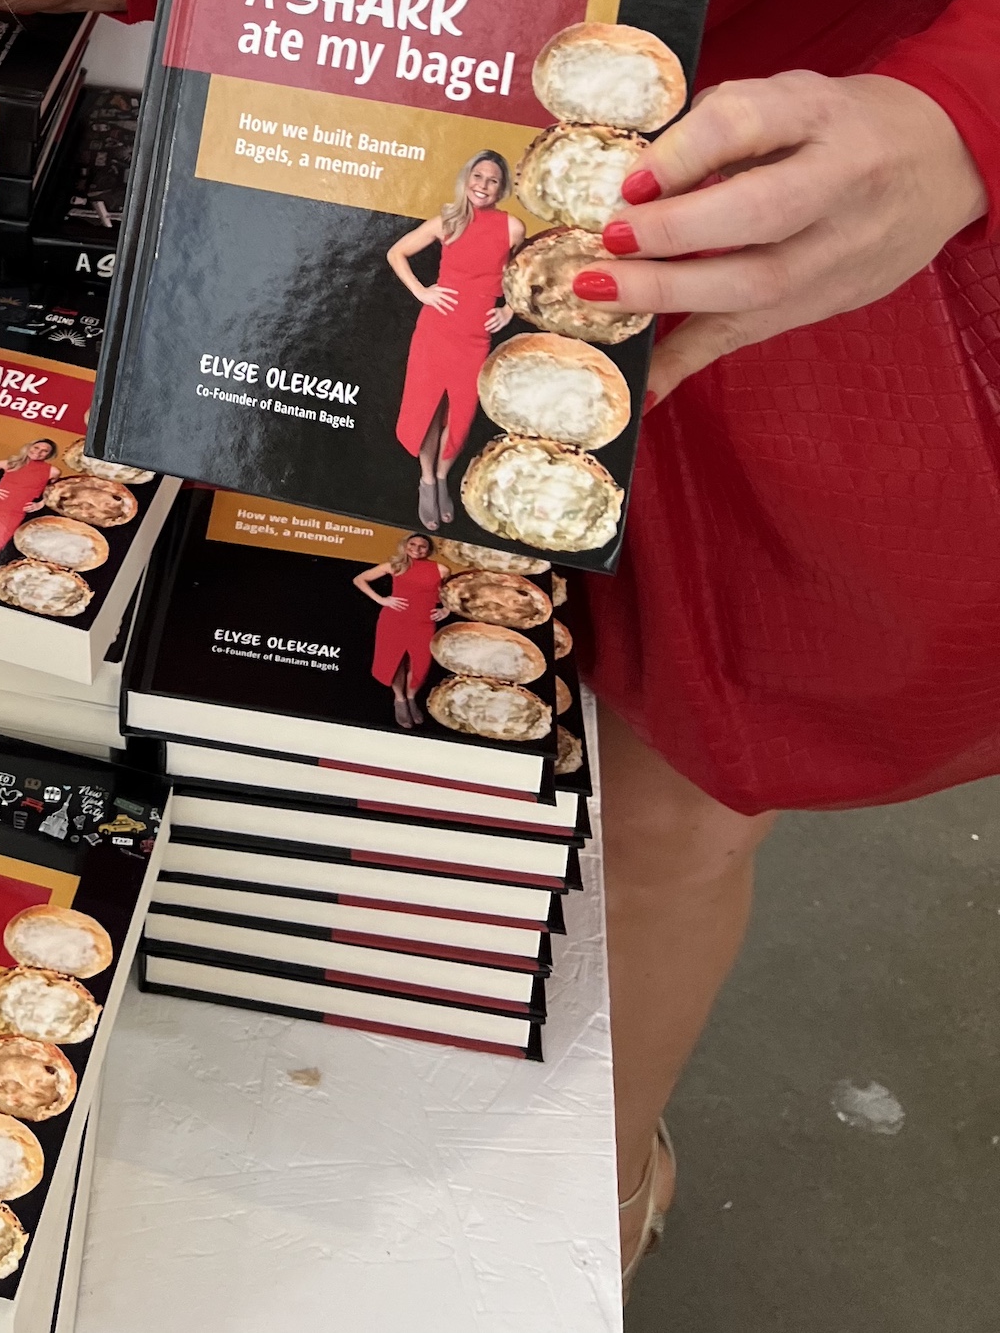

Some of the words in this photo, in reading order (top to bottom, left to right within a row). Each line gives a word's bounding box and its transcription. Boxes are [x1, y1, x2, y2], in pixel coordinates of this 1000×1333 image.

[237, 19, 303, 61] ate
[316, 33, 385, 85] my
[395, 34, 515, 101] bagel
[238, 112, 278, 134] How
[282, 123, 308, 140] we
[312, 124, 353, 148] built
[357, 132, 425, 161] Bantam
[234, 137, 292, 166] Bagels,
[298, 152, 310, 167] a
[314, 155, 383, 179] memoir
[74, 252, 92, 273] A
[199, 353, 259, 383] ELYSE
[265, 367, 360, 405] OLEKSAK
[195, 383, 258, 407] Co-Founder
[259, 398, 273, 410] of
[273, 400, 317, 420] Bantam
[318, 409, 355, 429] Bagels
[234, 520, 278, 536] Bagels,
[281, 528, 290, 536] a
[294, 530, 345, 544] memoir
[236, 508, 266, 520] How
[268, 514, 288, 524] we
[291, 515, 321, 528] built
[324, 521, 373, 536] Bantam
[213, 628, 261, 646] ELYSE
[266, 636, 341, 658] OLEKSAK
